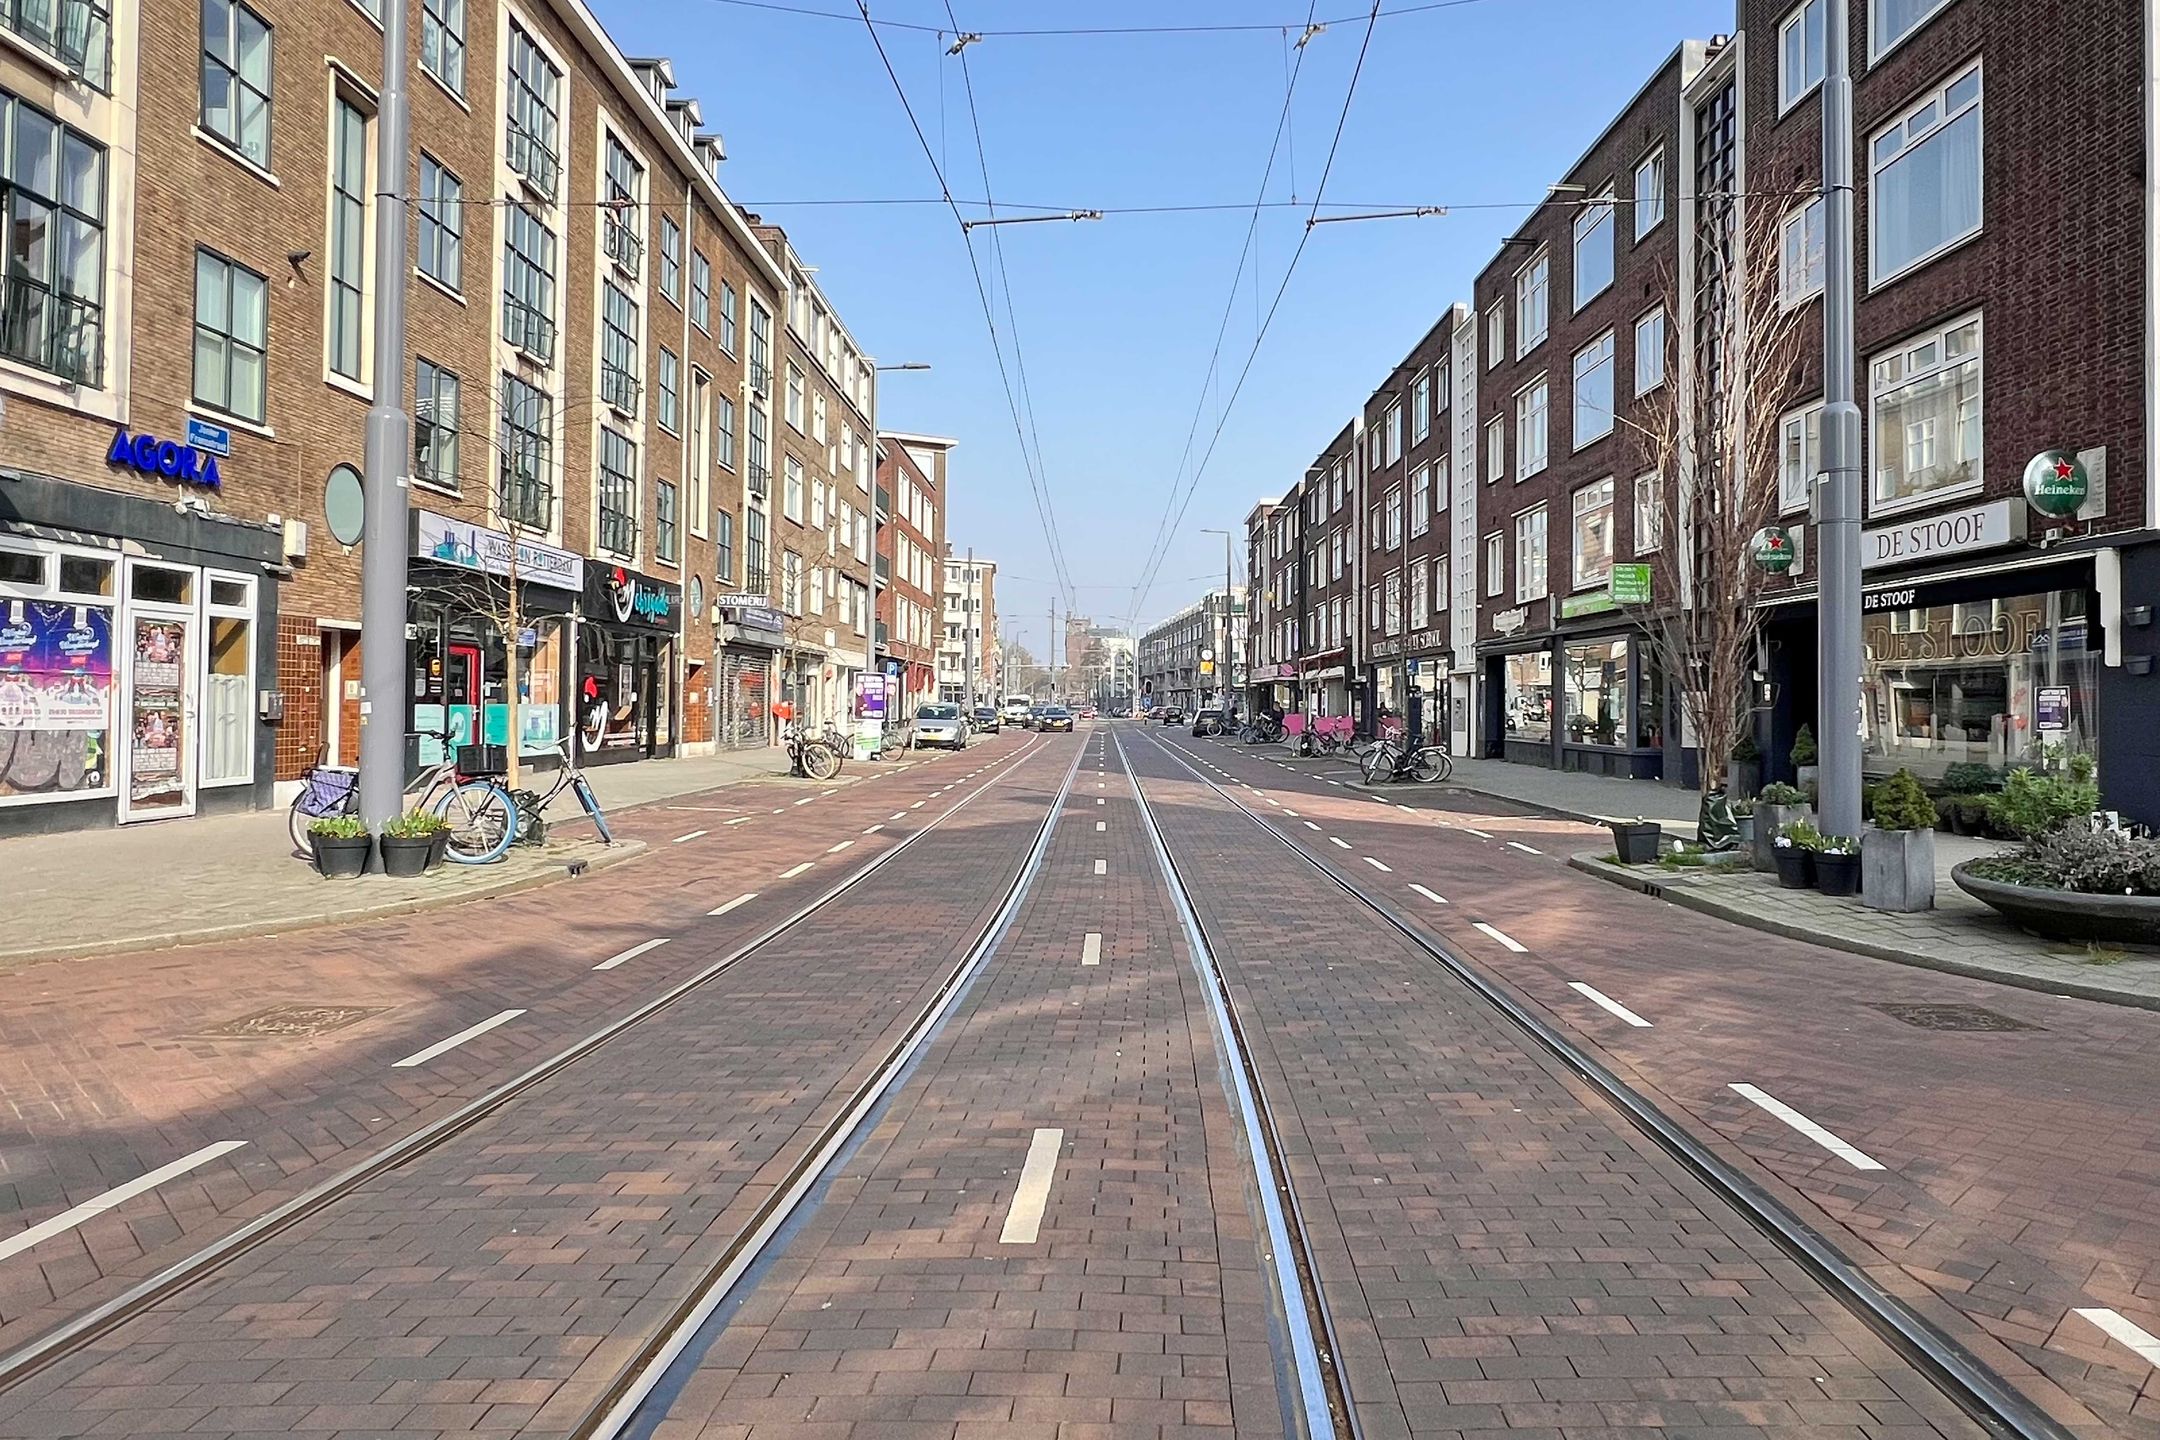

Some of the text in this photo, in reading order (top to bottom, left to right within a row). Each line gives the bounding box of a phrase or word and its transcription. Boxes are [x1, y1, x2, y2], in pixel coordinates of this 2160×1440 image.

[107, 430, 221, 488] AGORA
[2034, 484, 2086, 496] Heineken
[1876, 513, 1985, 560] DE STOOF
[1864, 589, 1915, 609] DE STOOF
[1871, 609, 2041, 662] DE STOOF
